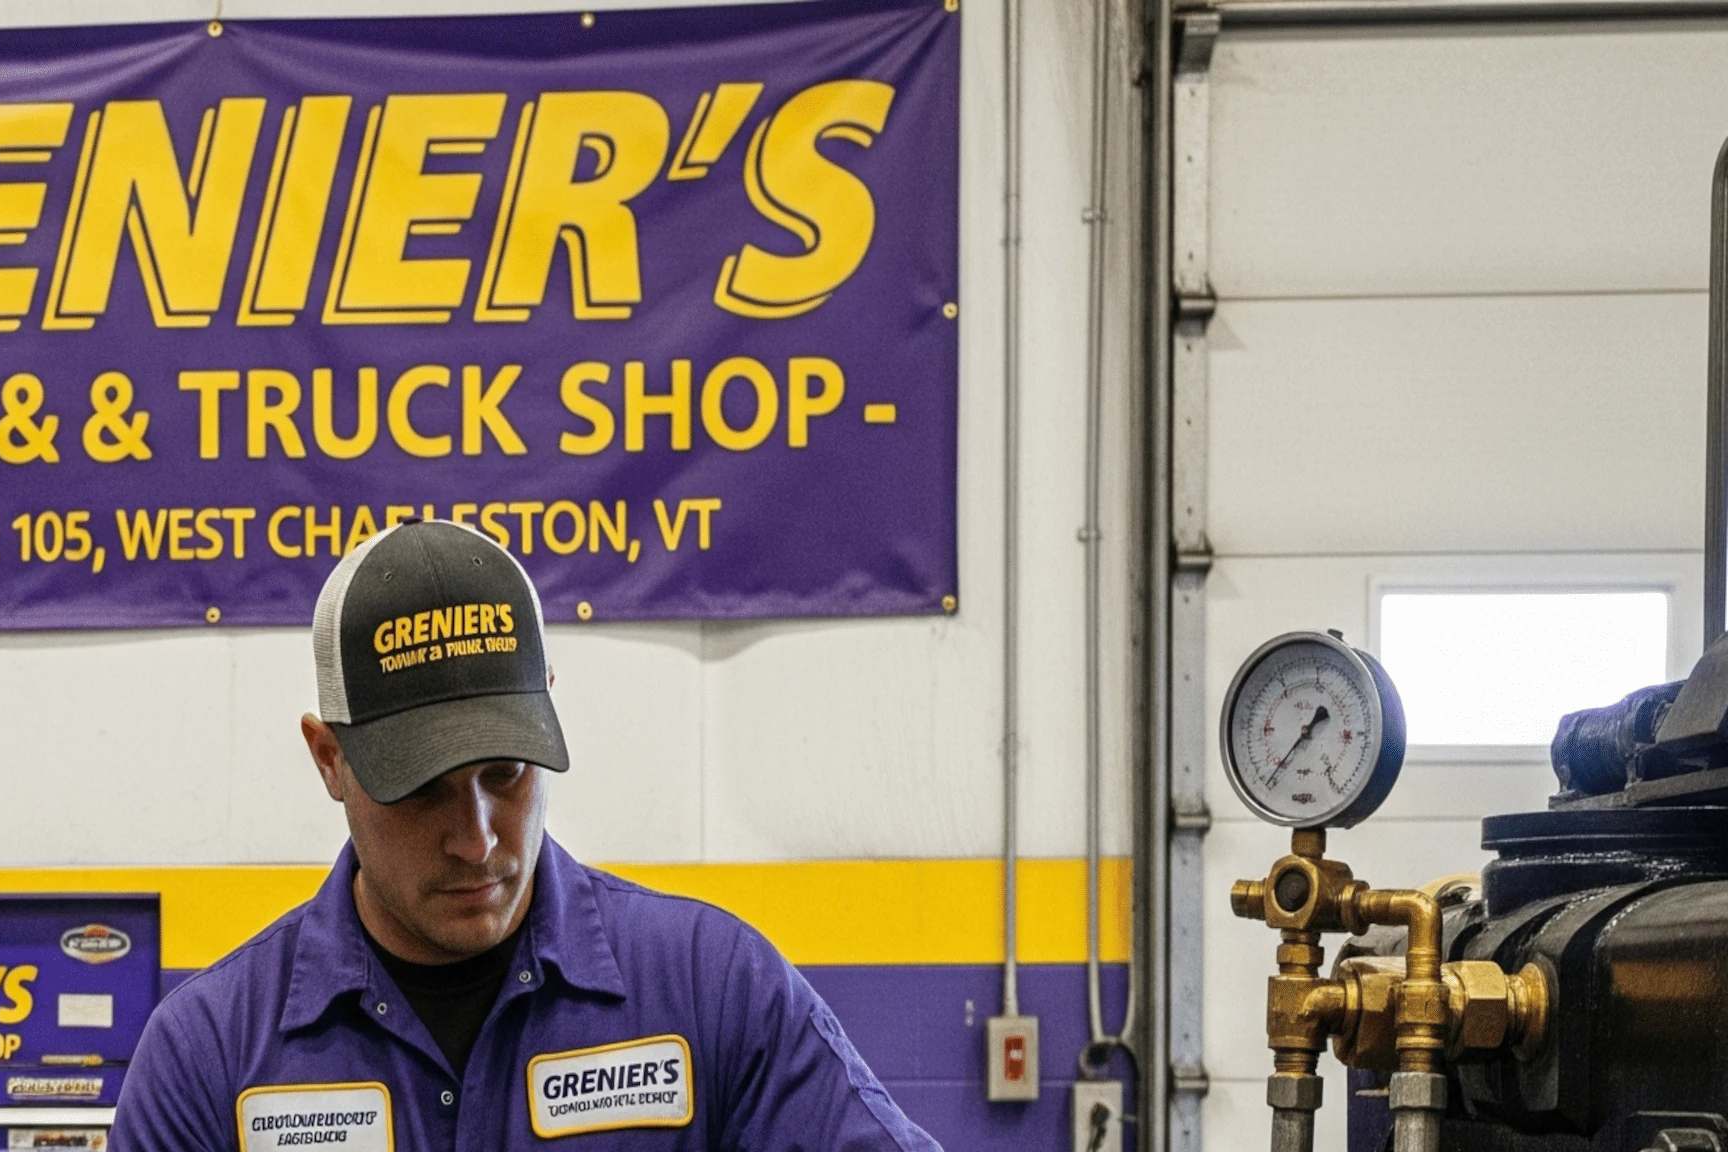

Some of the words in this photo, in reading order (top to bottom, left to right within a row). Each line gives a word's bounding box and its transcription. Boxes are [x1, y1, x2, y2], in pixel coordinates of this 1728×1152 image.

[82, 371, 152, 463] &
[179, 365, 527, 459] TRUCK
[559, 357, 845, 455] SHOP
[12, 511, 106, 572] 105,
[116, 508, 256, 560] WEST
[654, 498, 722, 550] VT
[374, 603, 515, 654] GRENIER'S
[543, 1058, 680, 1100] GRENIER'S
